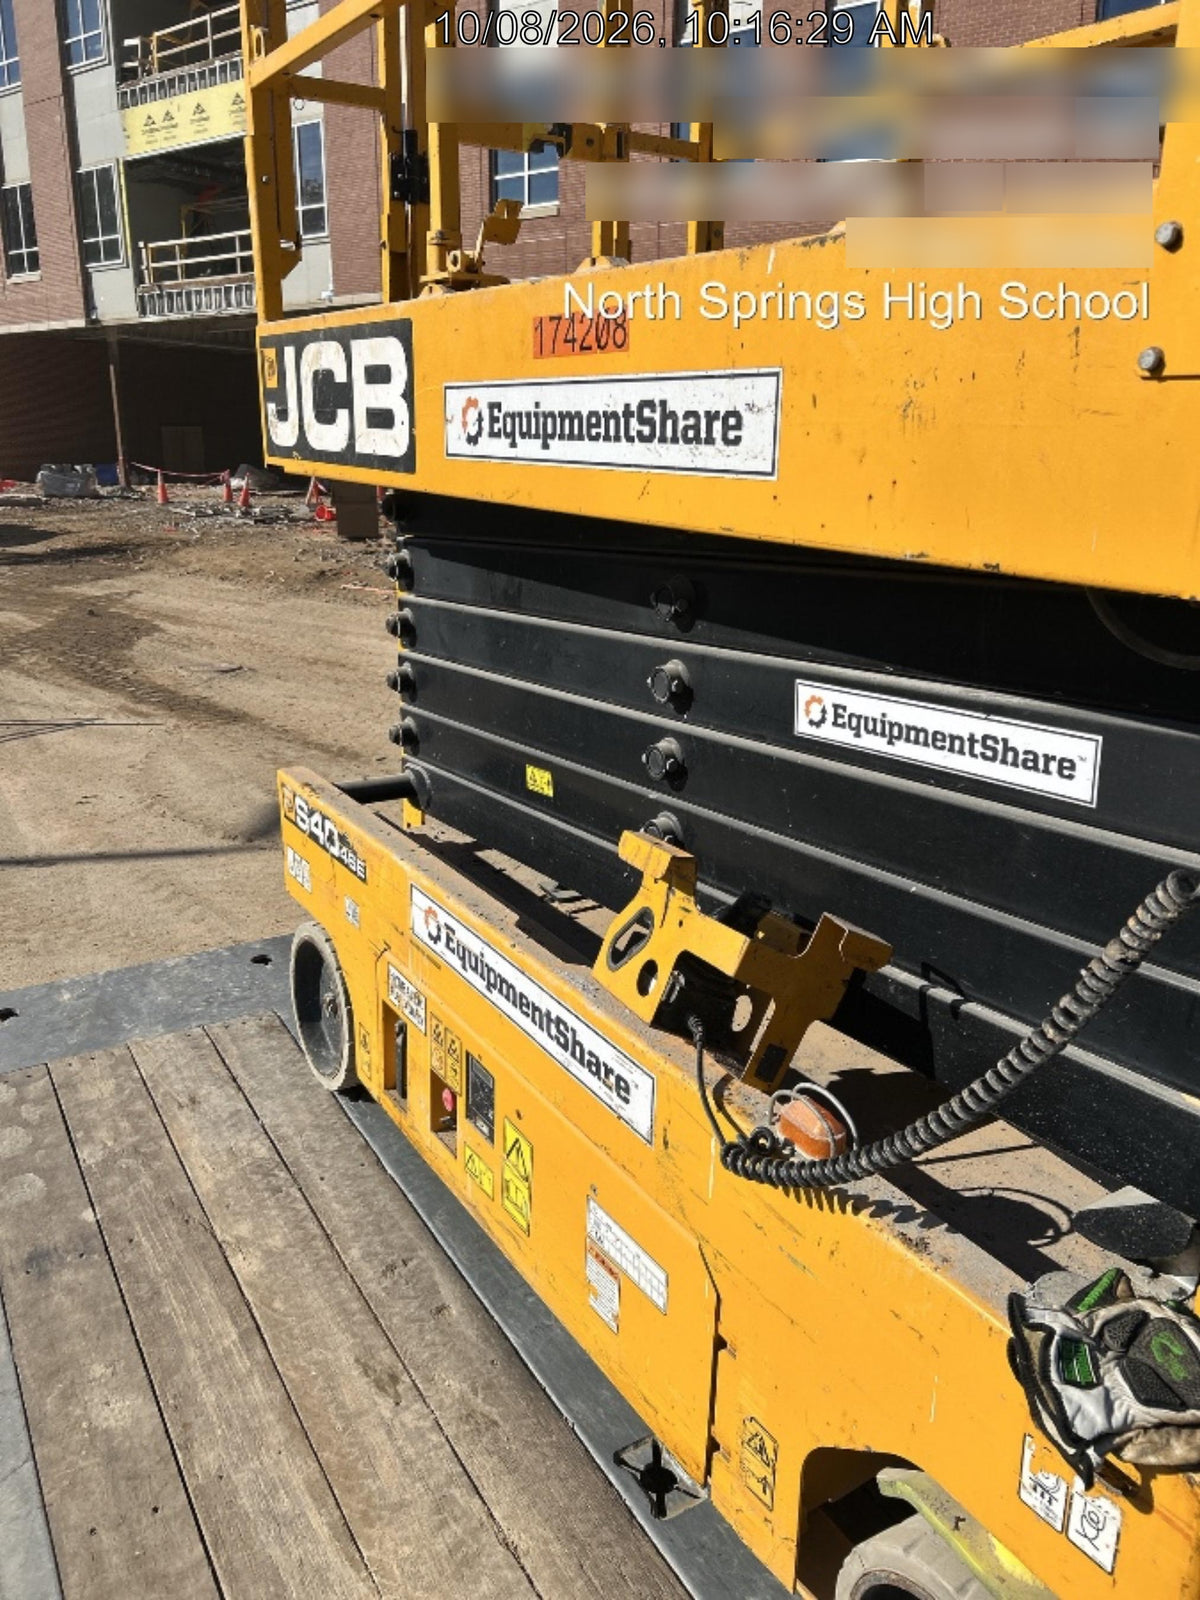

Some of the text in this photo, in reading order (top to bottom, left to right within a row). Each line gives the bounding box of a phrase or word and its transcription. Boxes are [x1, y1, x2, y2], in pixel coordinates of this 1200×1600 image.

[535, 308, 628, 357] 174208
[267, 336, 409, 457] JCB
[487, 398, 744, 450] EquipmentShare
[831, 702, 1077, 781] EquipmentShare
[444, 922, 631, 1104] EquipmentShare
